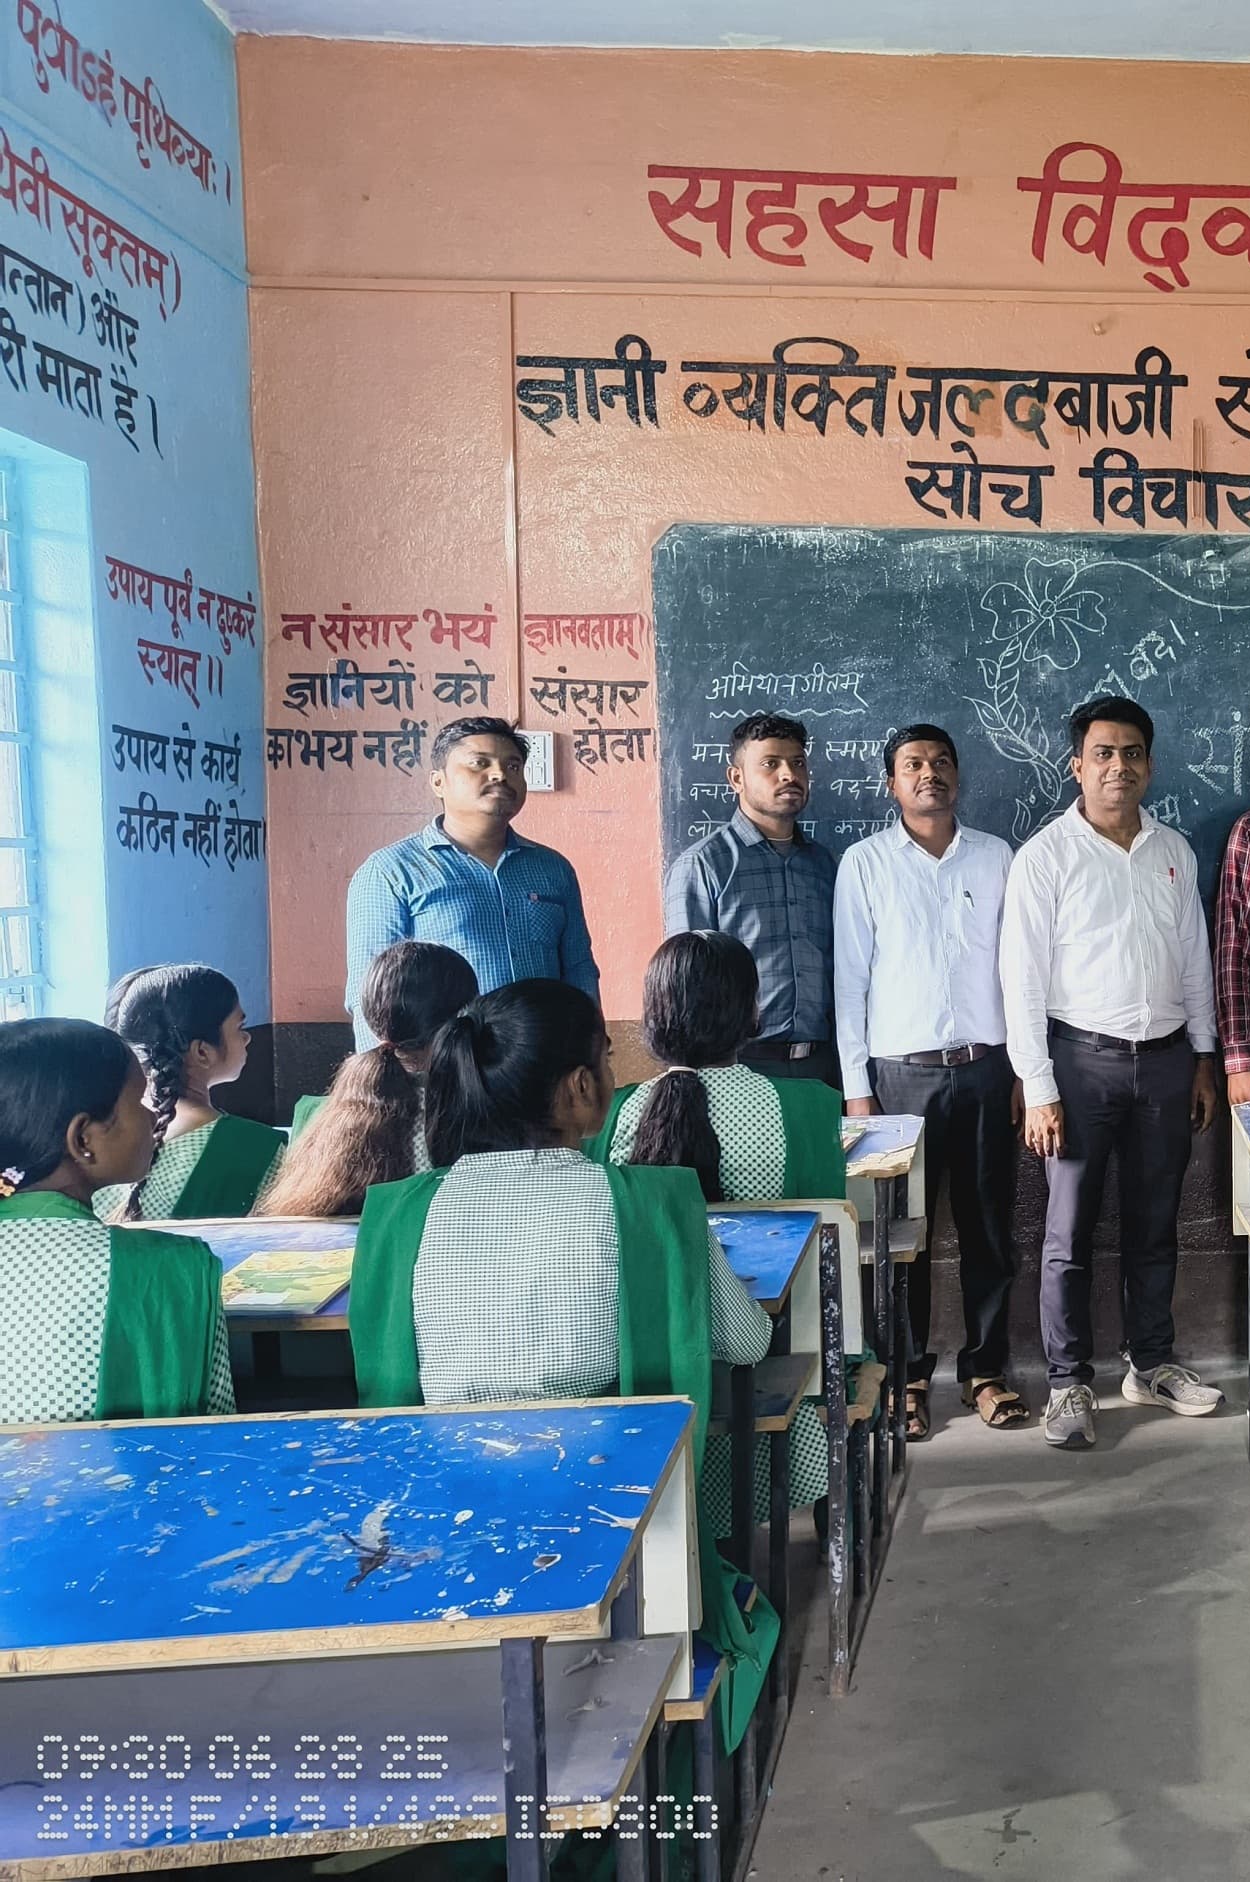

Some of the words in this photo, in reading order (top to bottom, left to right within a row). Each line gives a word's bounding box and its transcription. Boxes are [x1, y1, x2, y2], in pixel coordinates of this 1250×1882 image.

[648, 163, 957, 267] सहसा
[91, 288, 140, 368] और
[32, 341, 105, 425] माता
[516, 334, 667, 437] ज्ञानी
[681, 336, 896, 437] व्यक्ति
[904, 440, 1055, 529] सोच
[105, 554, 153, 614] उपाय
[197, 587, 216, 629] न
[281, 613, 317, 650] न
[318, 602, 419, 654] संसार
[422, 602, 498, 651] भयं
[282, 658, 417, 718] ज्ञानियों
[432, 658, 496, 709] को
[529, 665, 650, 718] संसार
[111, 723, 170, 775] उपाय
[173, 721, 196, 783] से
[200, 731, 242, 787] कार्य
[266, 727, 294, 770] का
[293, 730, 359, 771] भय
[362, 717, 430, 777] नहीं
[116, 791, 180, 857] कठिन
[182, 797, 223, 868] नहीं
